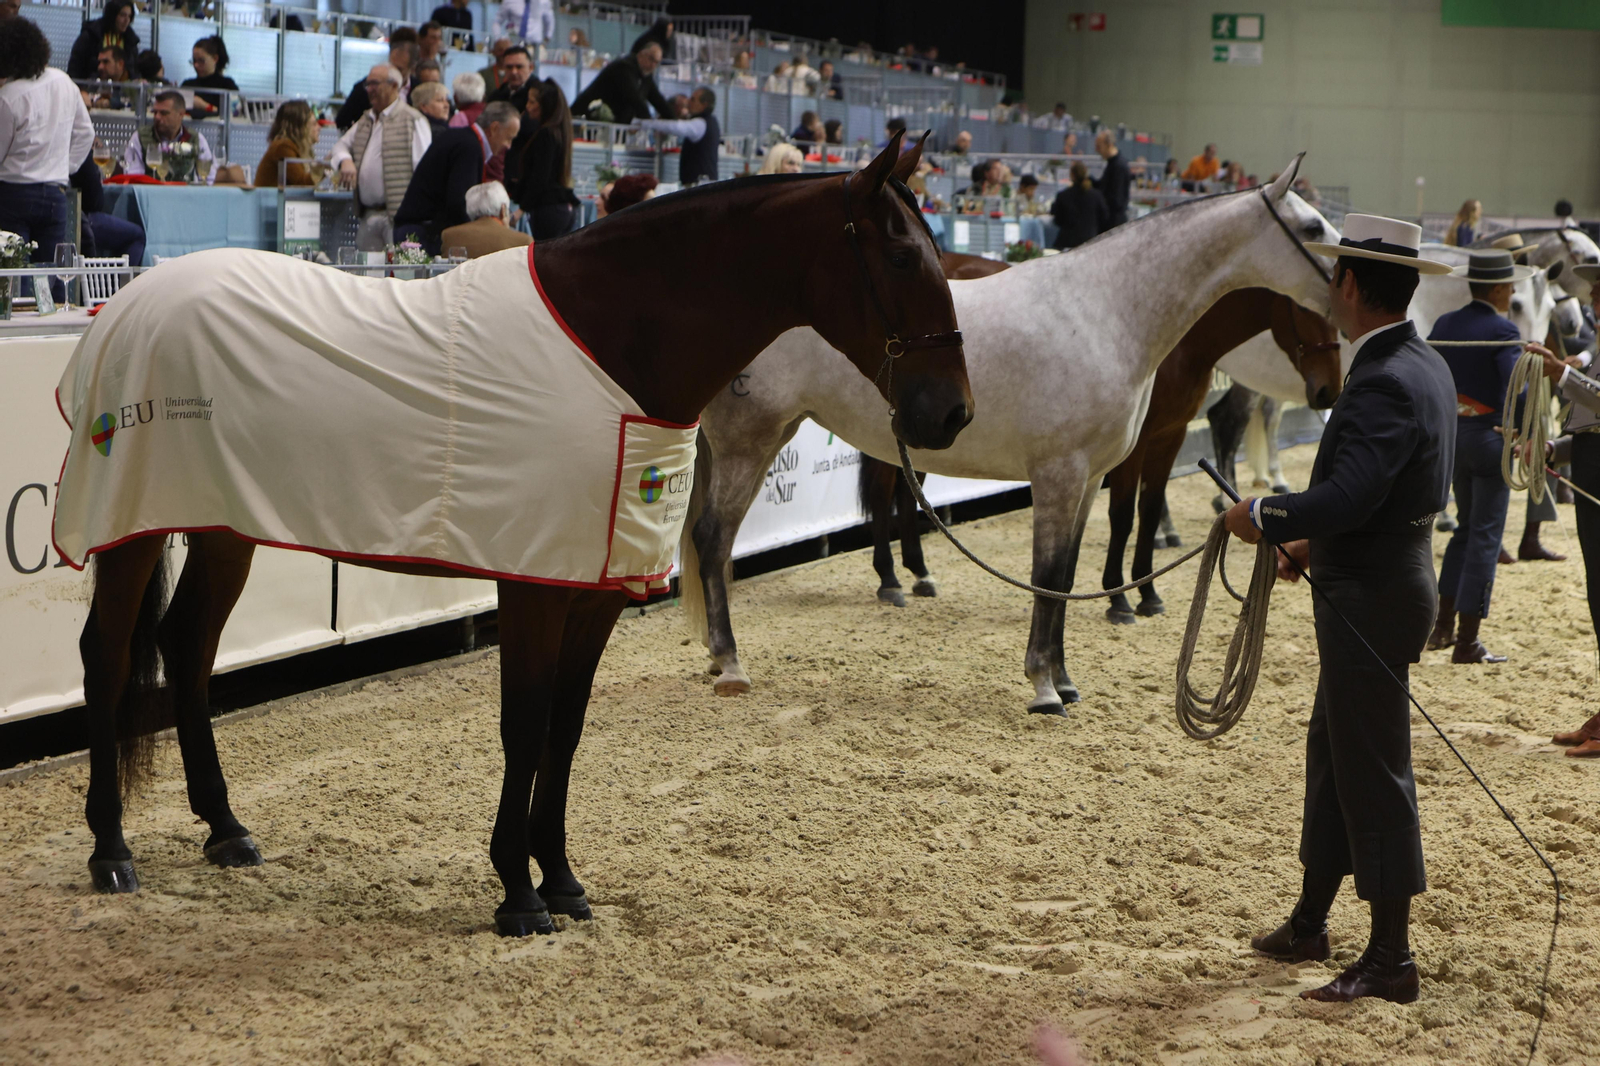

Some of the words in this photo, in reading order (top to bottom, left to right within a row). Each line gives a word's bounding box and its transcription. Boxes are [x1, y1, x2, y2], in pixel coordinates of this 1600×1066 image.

[114, 399, 155, 432] EU
[668, 471, 693, 494] CEU
[775, 474, 797, 505] Sur
